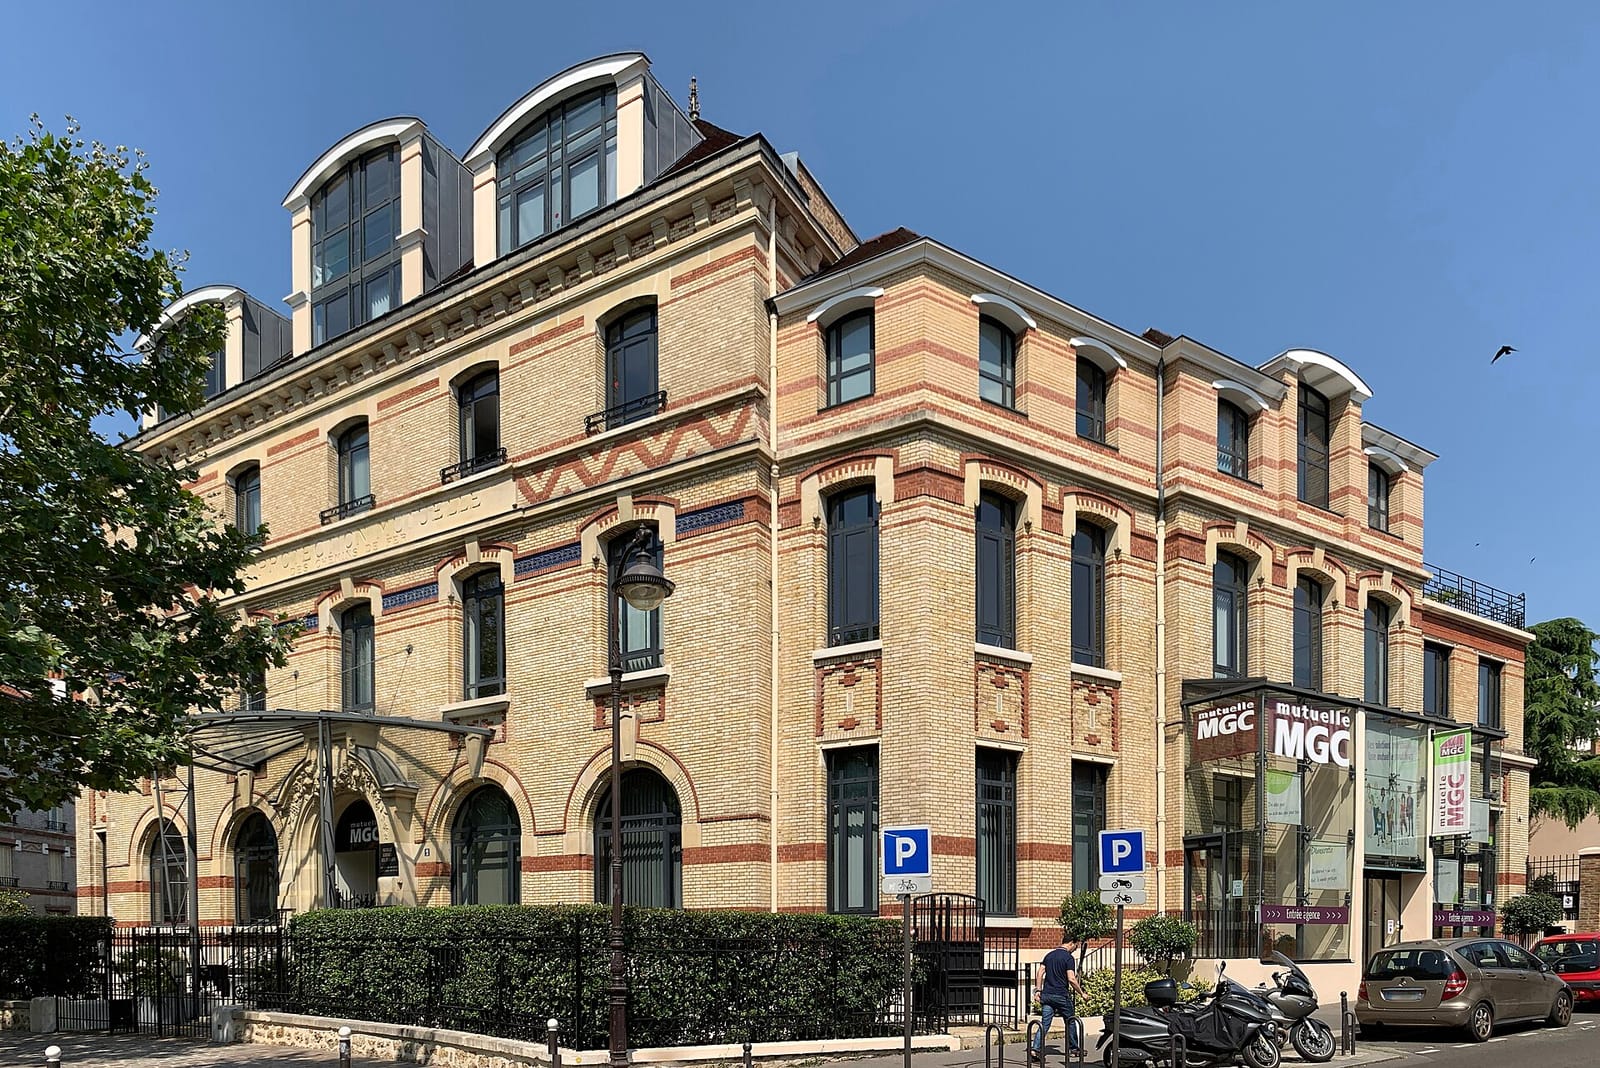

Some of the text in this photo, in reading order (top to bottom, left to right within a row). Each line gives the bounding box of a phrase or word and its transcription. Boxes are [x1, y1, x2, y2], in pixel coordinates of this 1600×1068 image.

[1198, 701, 1255, 720] mutuelle
[1276, 702, 1350, 728] mutuelle
[1197, 710, 1255, 740] MGC
[1274, 718, 1350, 768] MGC
[1441, 746, 1464, 756] MGC
[1447, 774, 1465, 827] MGC
[350, 827, 379, 843] MGC
[896, 837, 917, 867] P
[1112, 839, 1132, 866] P
[1286, 908, 1321, 922] Entrée agence
